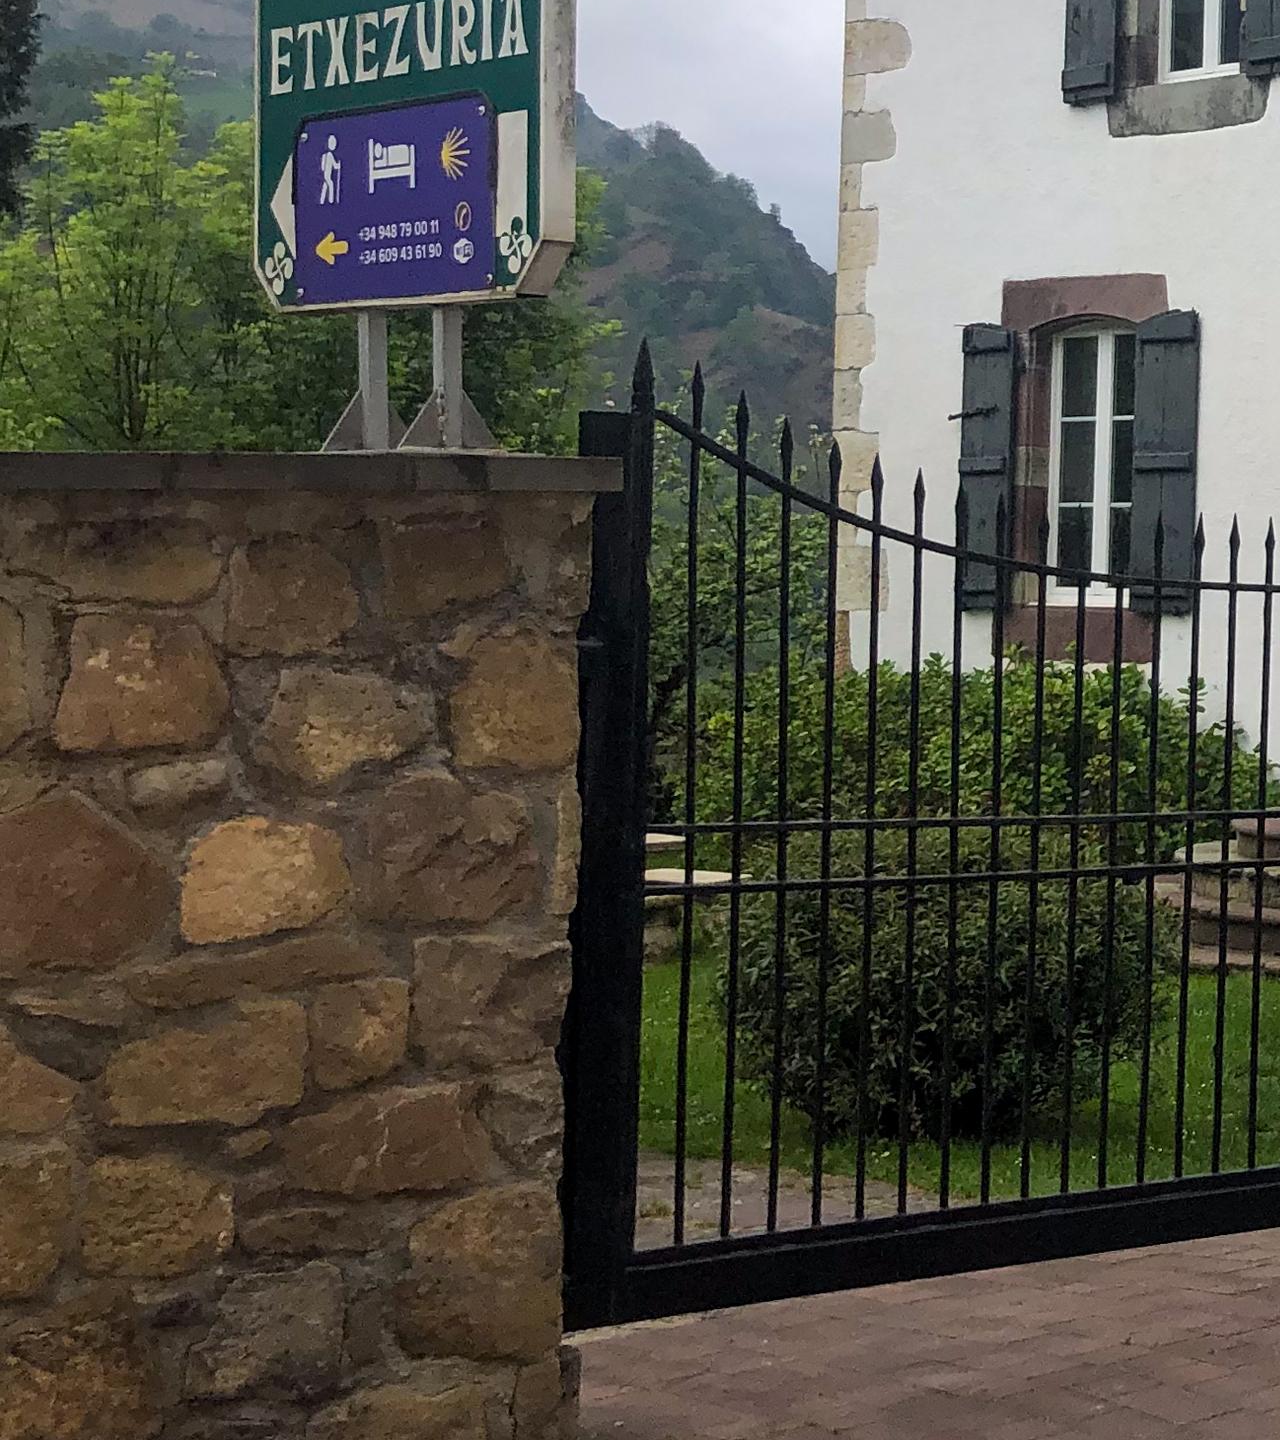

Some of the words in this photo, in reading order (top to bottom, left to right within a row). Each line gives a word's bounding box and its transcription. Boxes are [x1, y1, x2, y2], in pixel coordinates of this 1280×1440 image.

[378, 224, 398, 240] 948
[400, 222, 413, 237] 79
[414, 220, 428, 236] 00
[430, 219, 440, 235] 11
[378, 247, 399, 263] 609
[400, 245, 413, 261] 43
[415, 244, 427, 259] 61
[428, 242, 443, 259] 90
